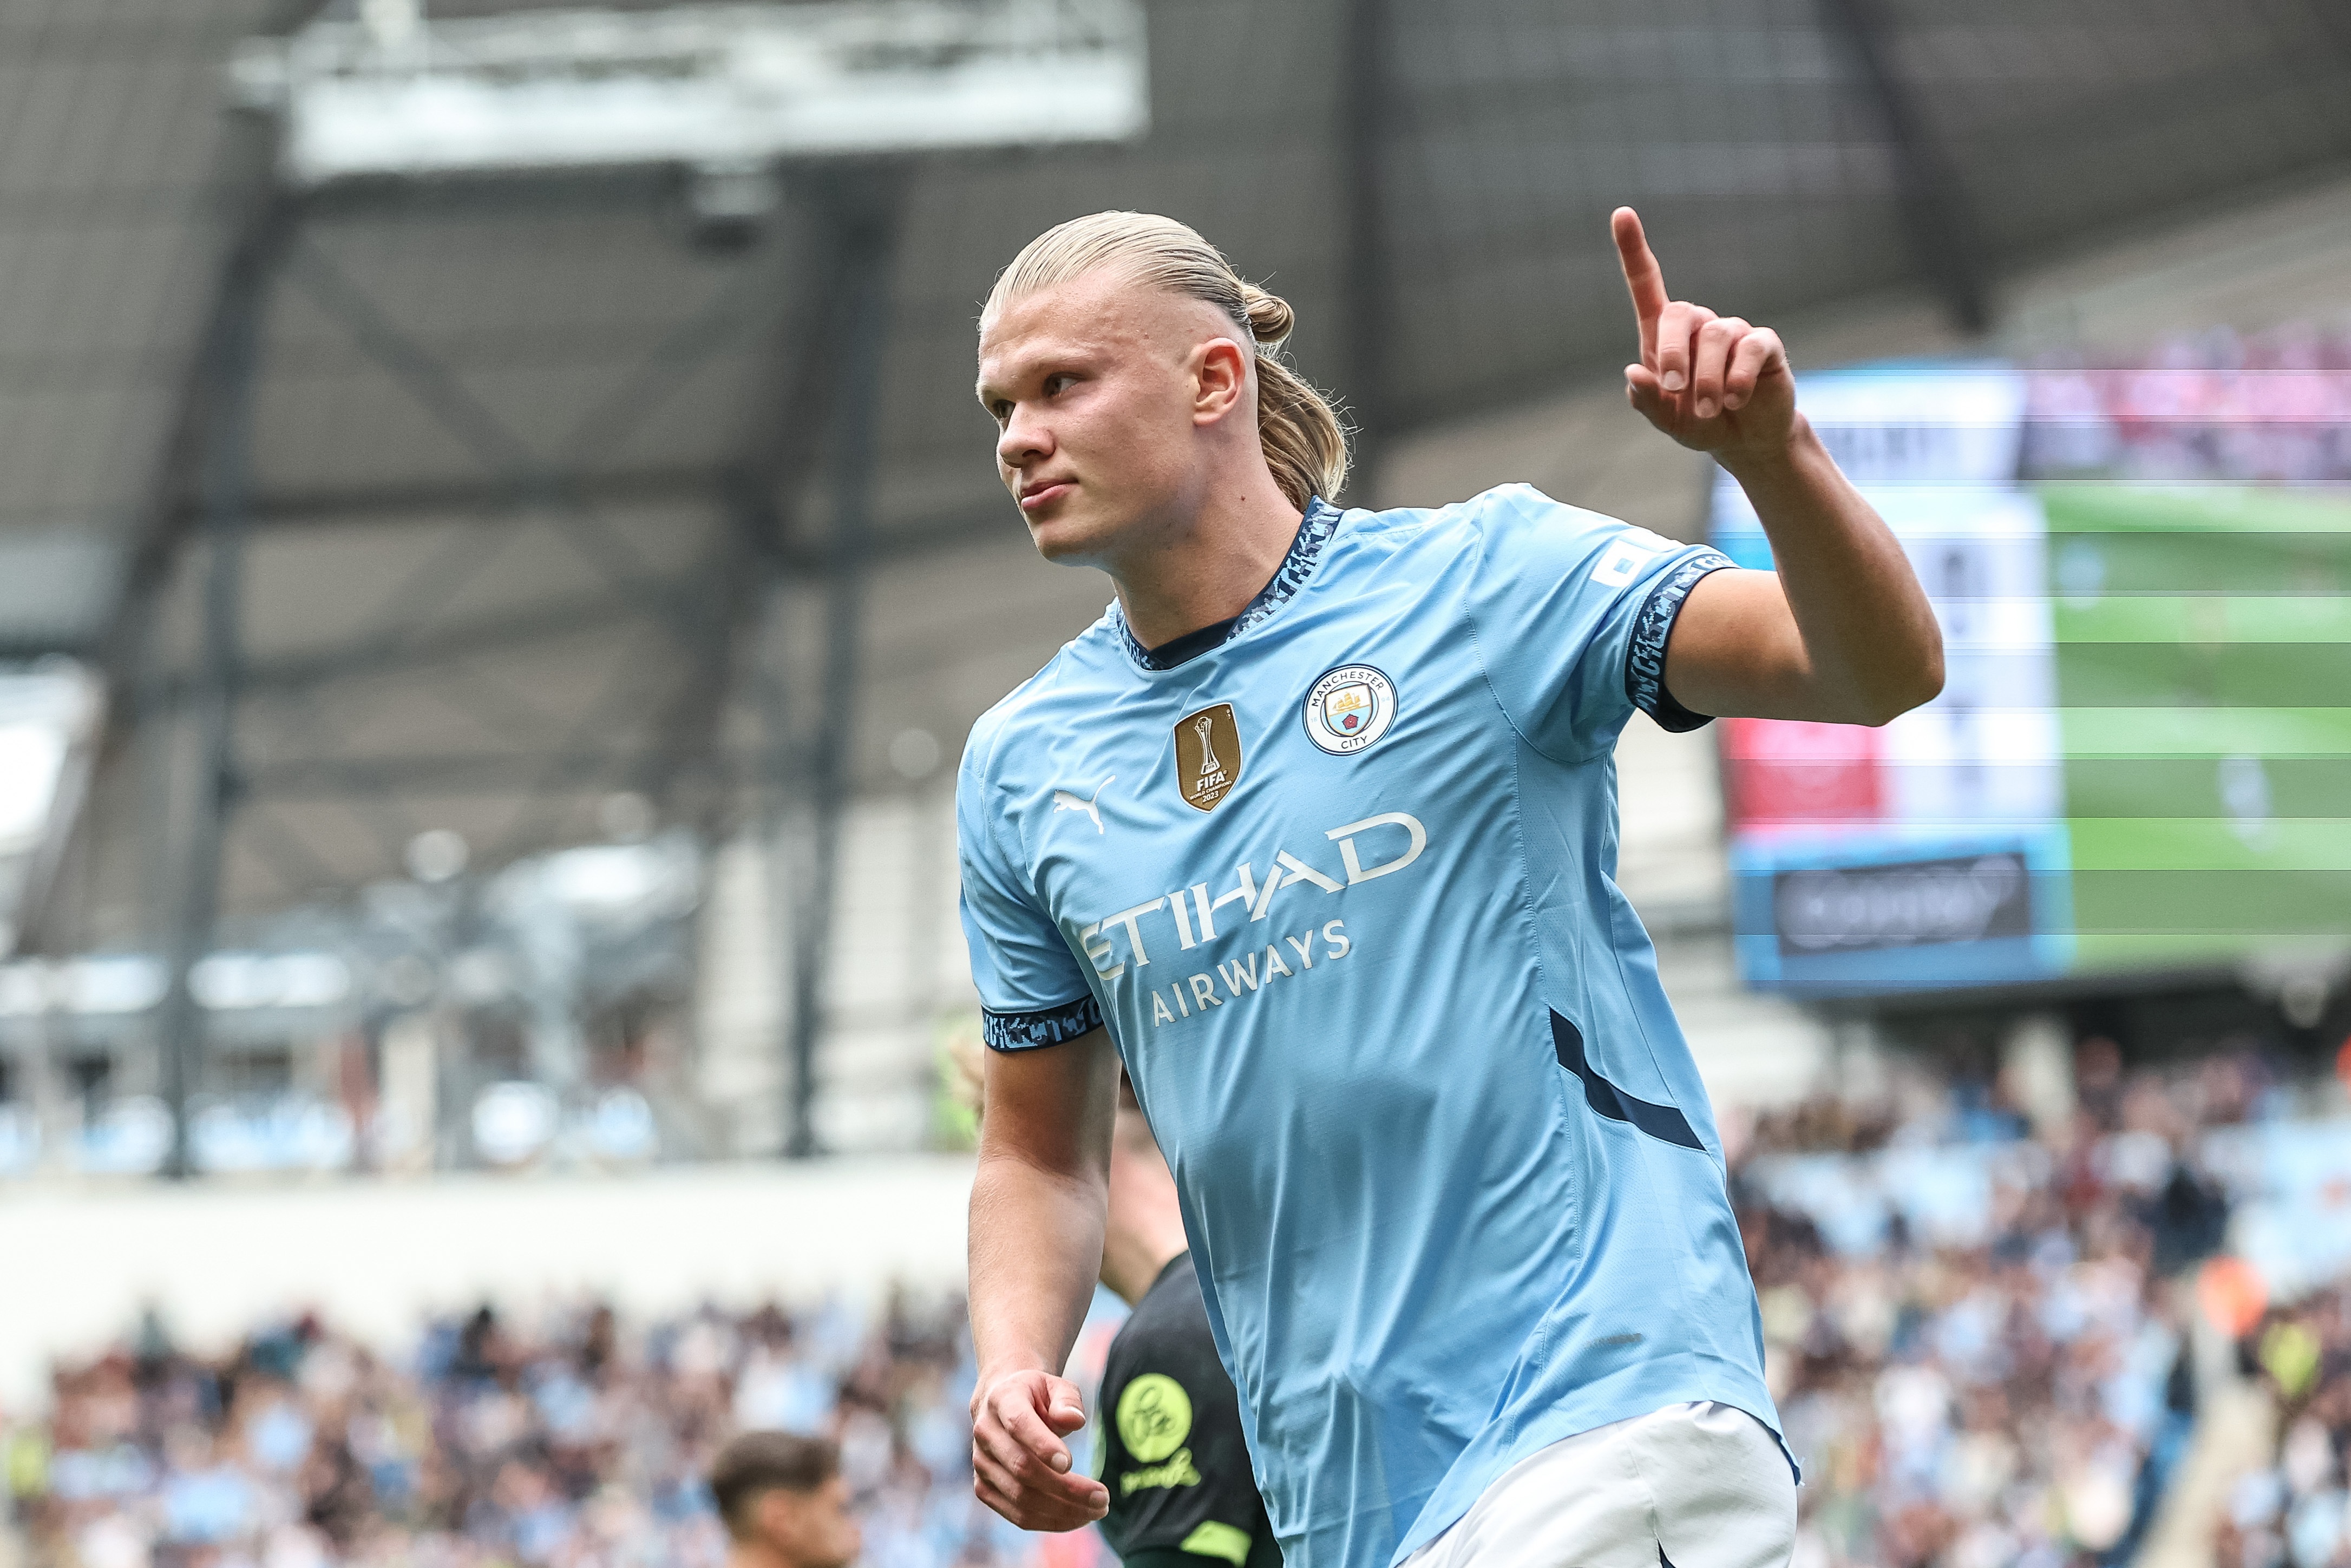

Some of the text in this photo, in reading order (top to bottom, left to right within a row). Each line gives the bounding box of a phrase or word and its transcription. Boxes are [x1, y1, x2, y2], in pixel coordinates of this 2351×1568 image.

[1312, 672, 1384, 706] MANCHESTER
[1341, 736, 1367, 749] CITY
[1190, 780, 1232, 800] WORLD CHAMPIONS
[1197, 771, 1225, 791] FIFA
[1202, 791, 1219, 802] 2023
[1079, 812, 1427, 981] ETIHAD
[1152, 919, 1351, 1027] AIRWAYS
